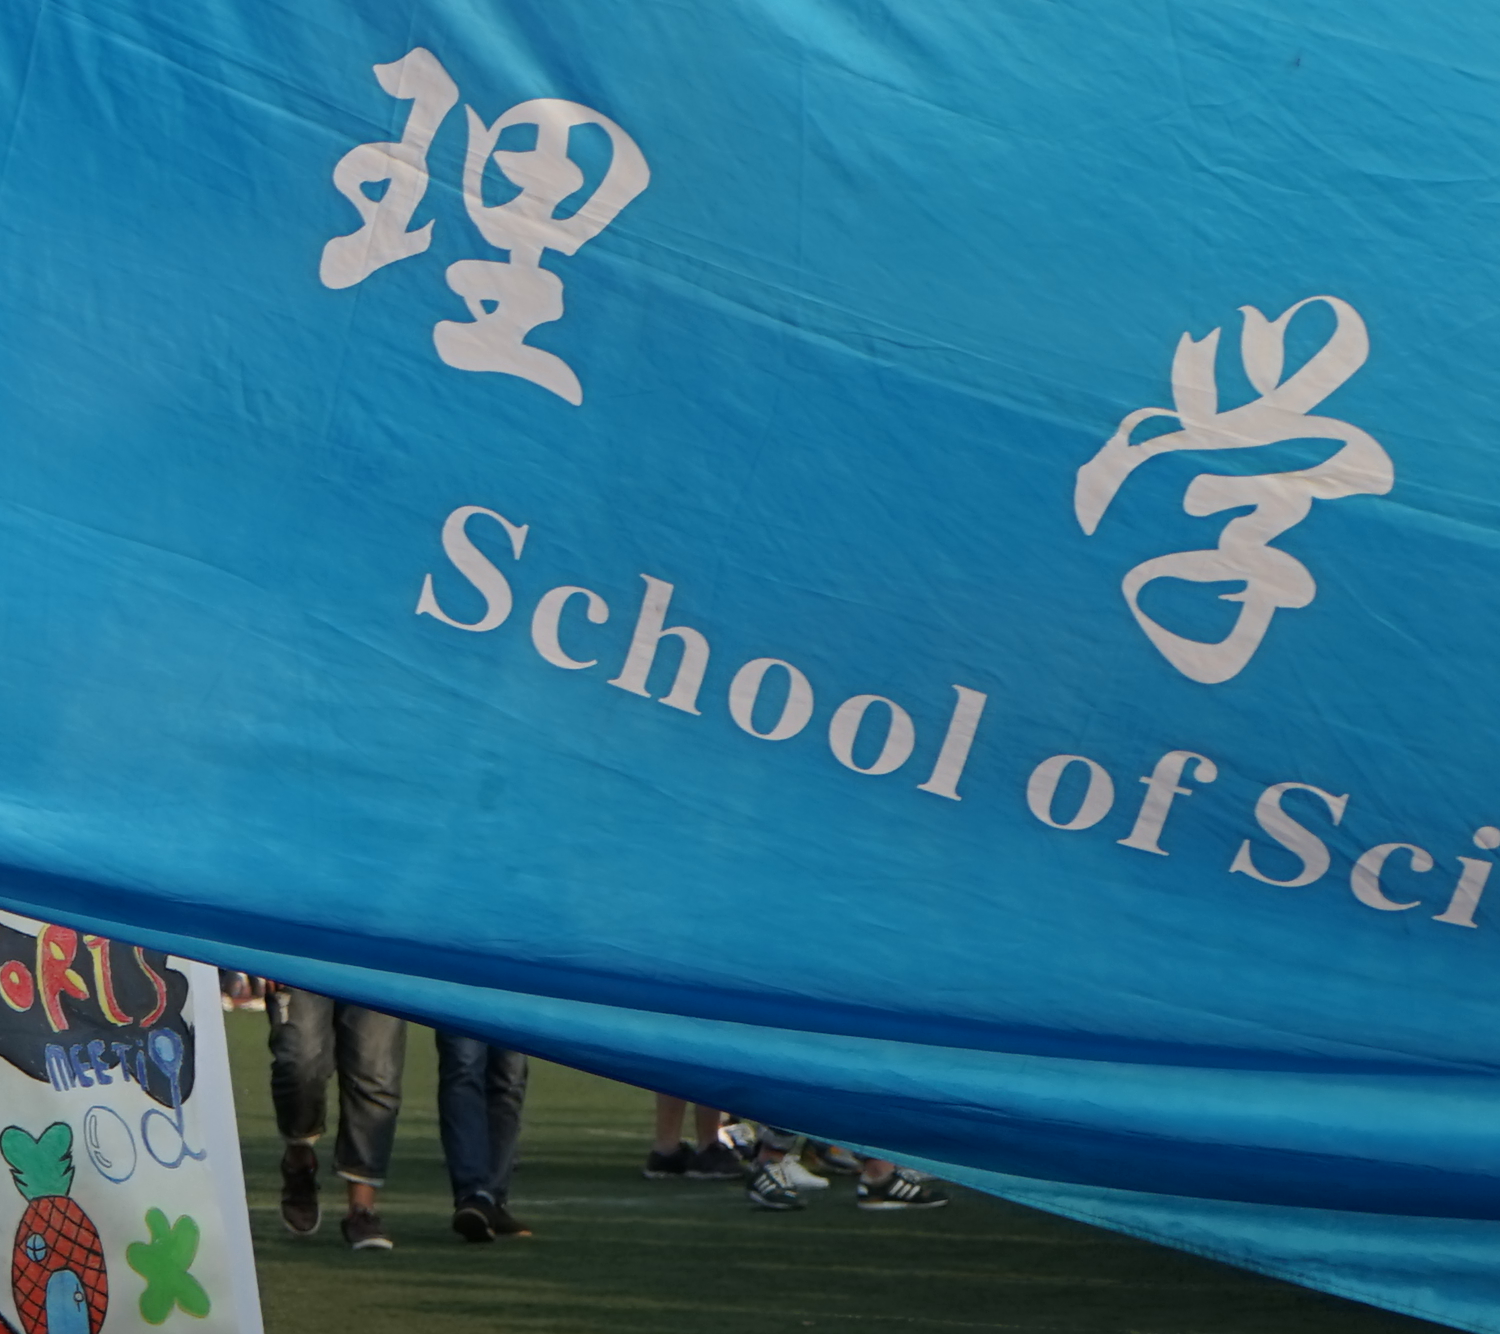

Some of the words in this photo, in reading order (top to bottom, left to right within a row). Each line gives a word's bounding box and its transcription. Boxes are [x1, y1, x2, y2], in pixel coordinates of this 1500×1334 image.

[413, 504, 988, 802] School
[1024, 748, 1220, 857] of
[1227, 780, 1500, 929] Sci
